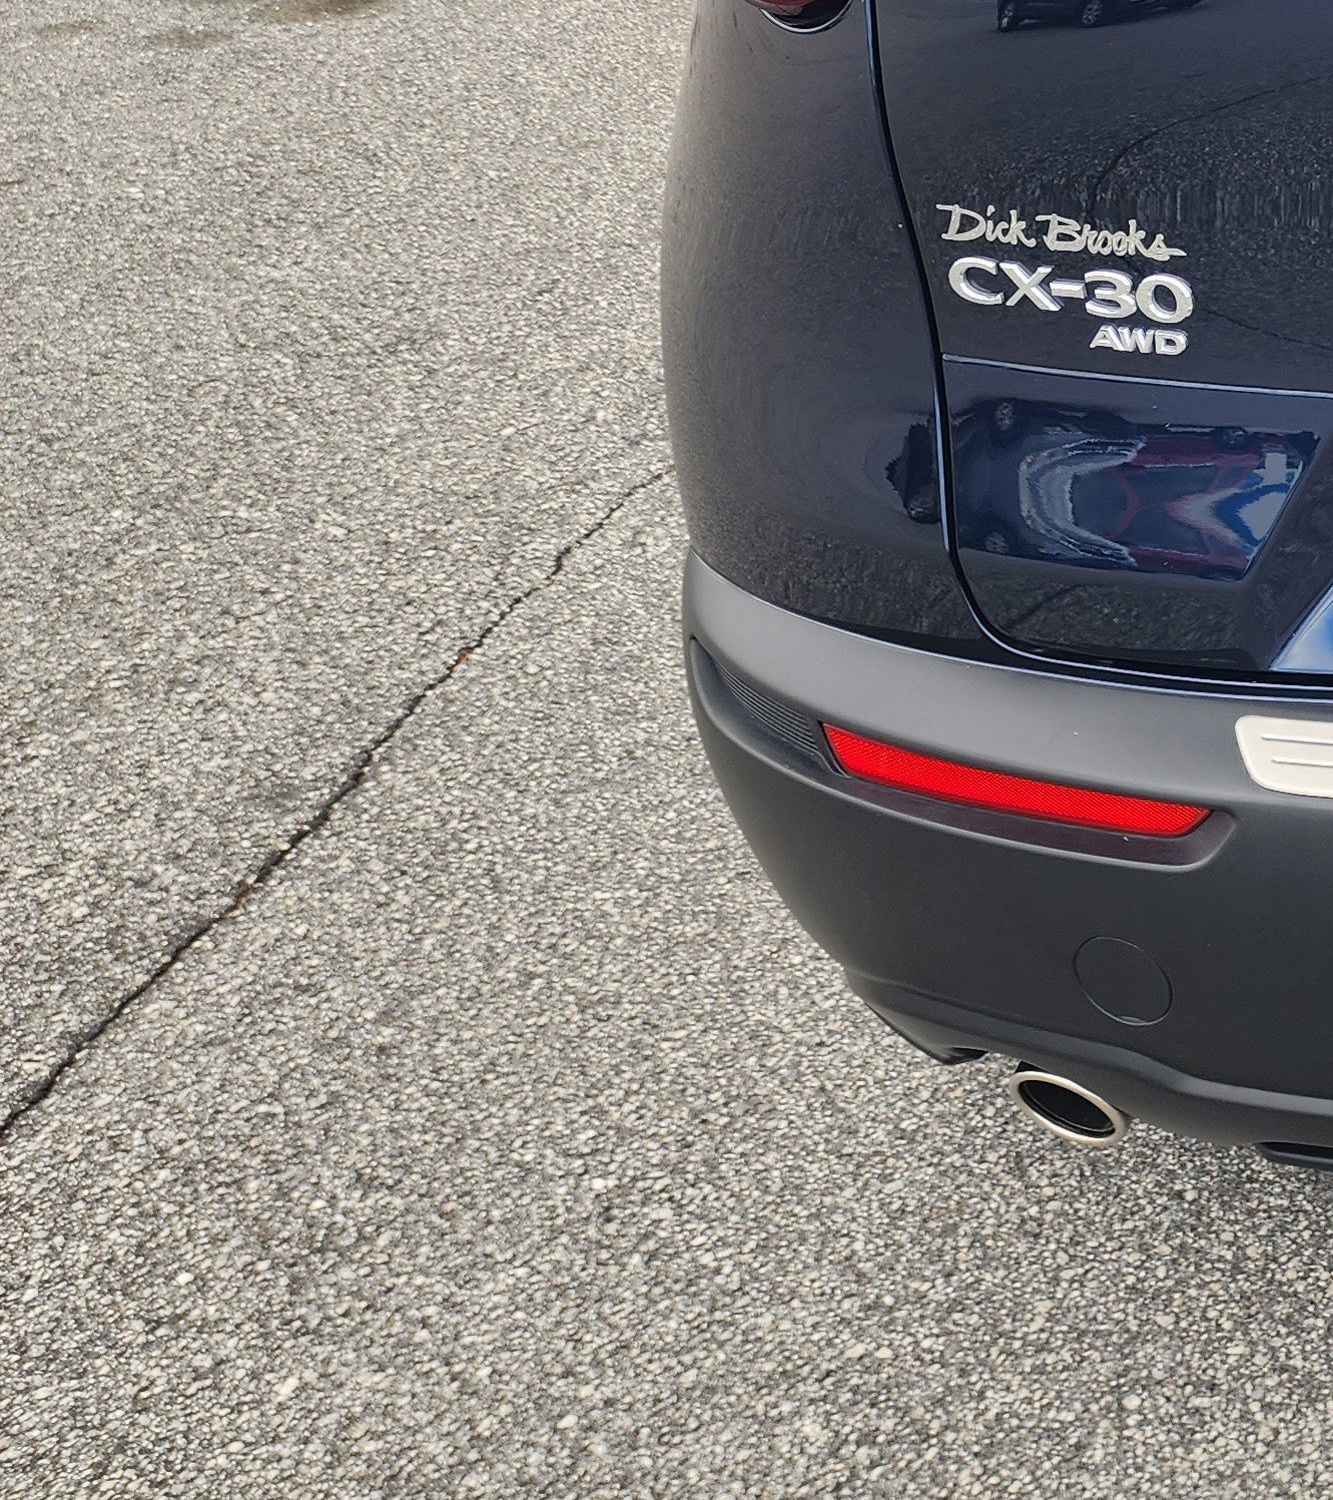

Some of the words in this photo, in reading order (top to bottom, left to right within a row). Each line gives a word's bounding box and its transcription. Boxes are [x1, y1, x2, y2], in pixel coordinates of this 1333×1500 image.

[936, 203, 1036, 248] Dick
[1036, 213, 1188, 261] Brooks
[948, 256, 1194, 324] CX-30
[1089, 324, 1189, 356] AWD
